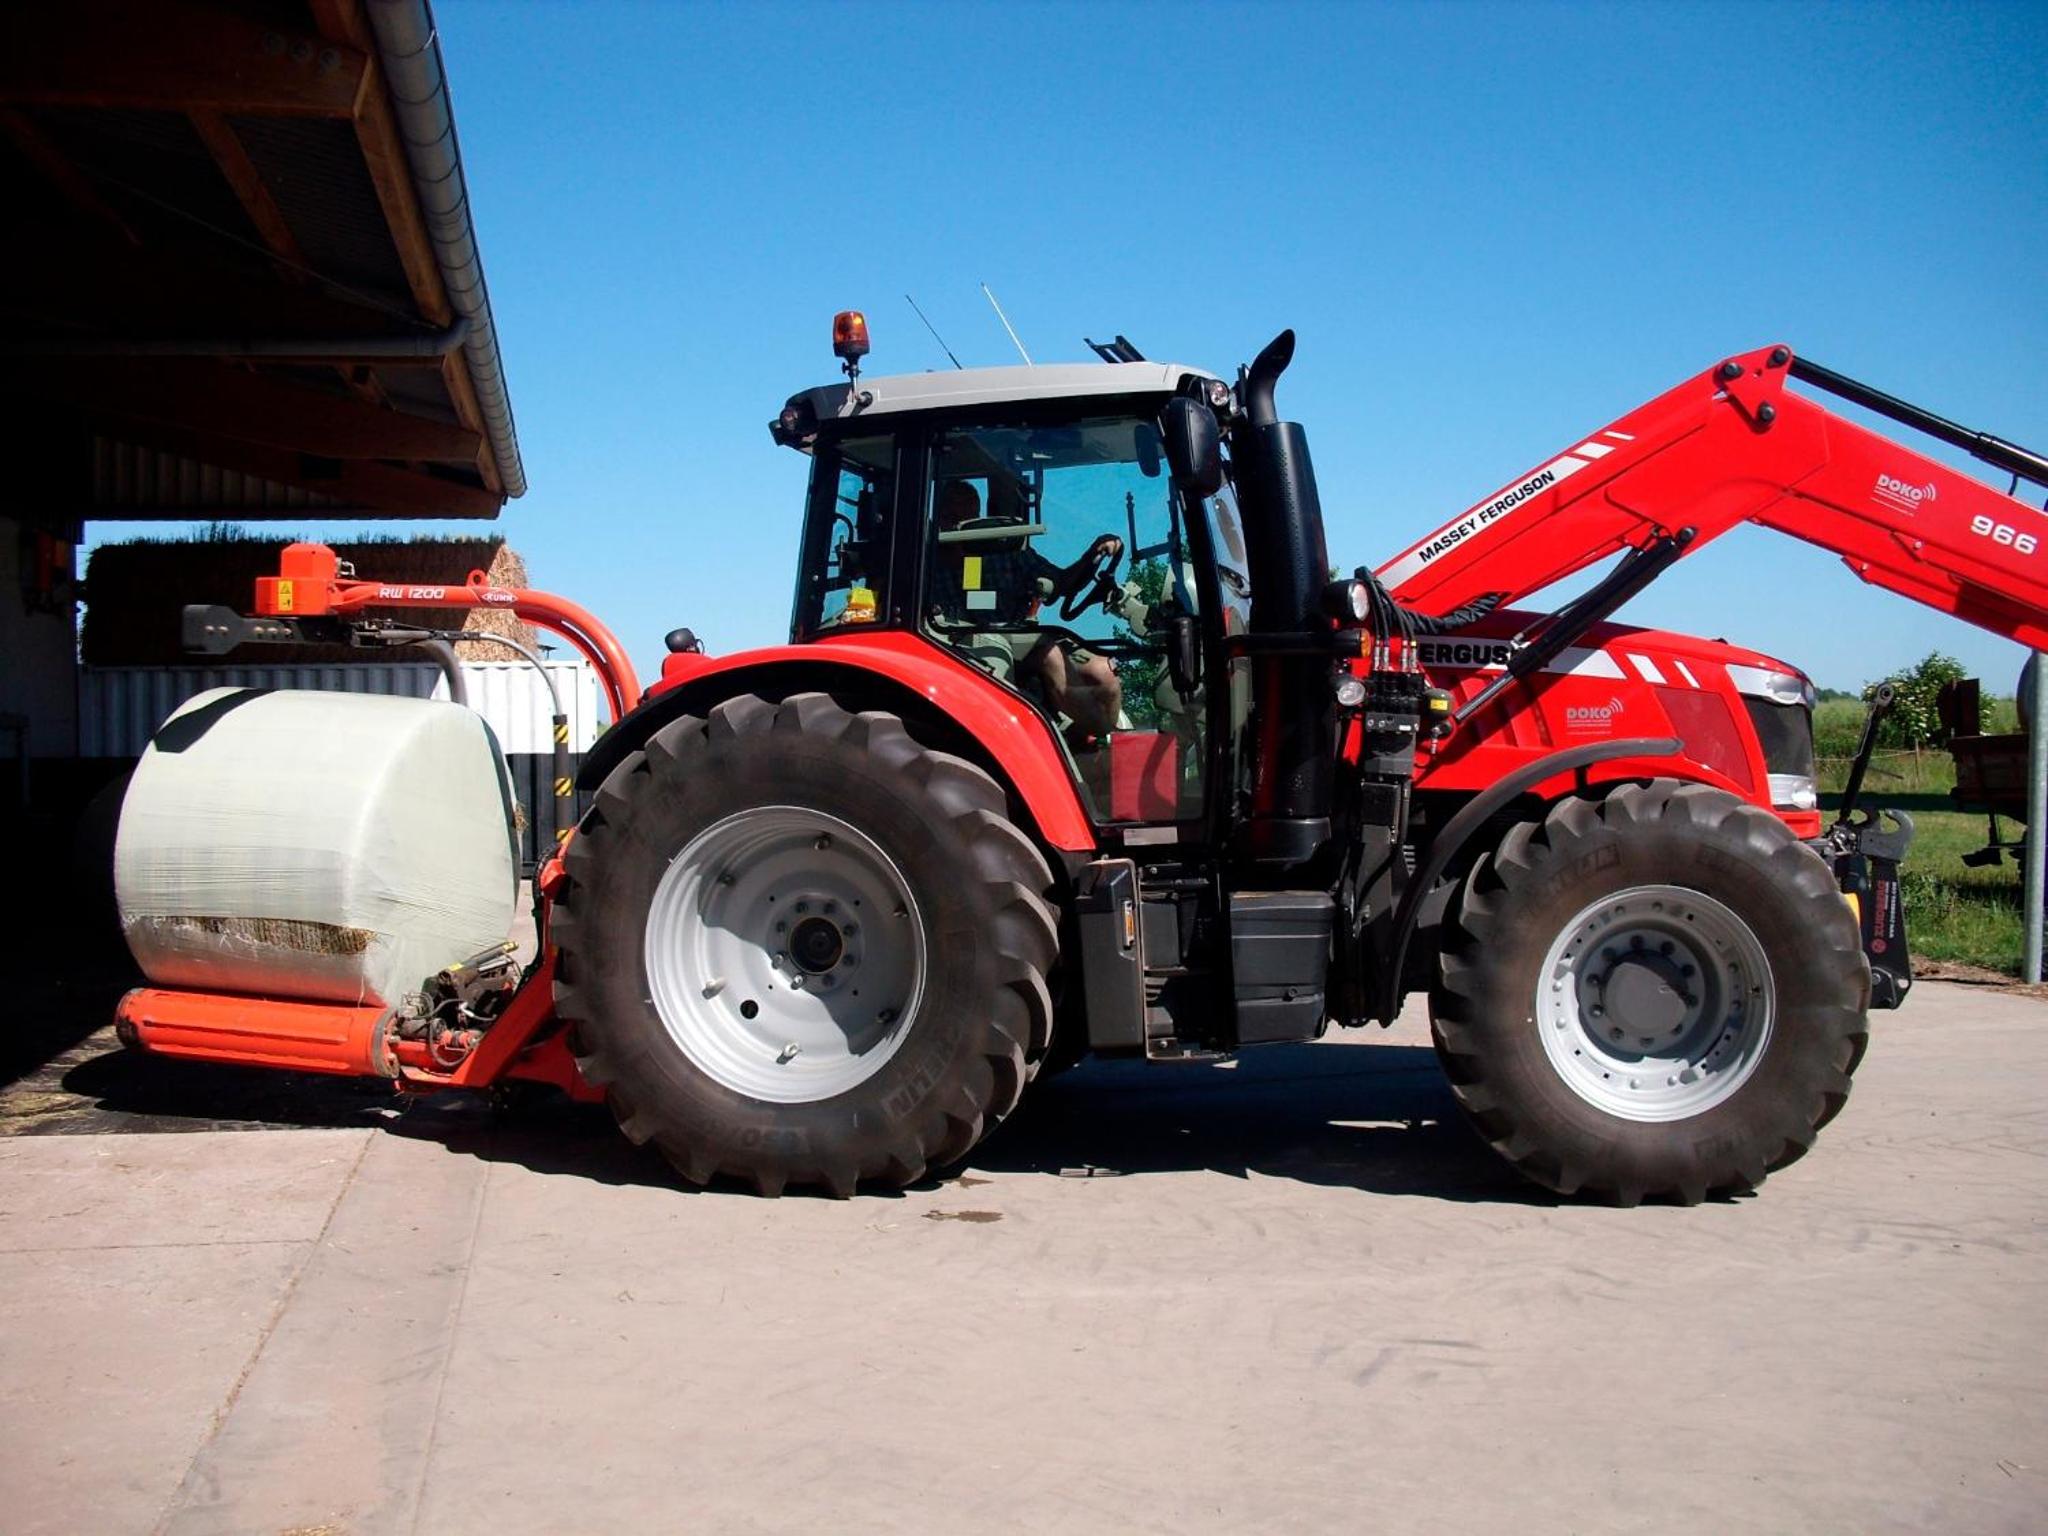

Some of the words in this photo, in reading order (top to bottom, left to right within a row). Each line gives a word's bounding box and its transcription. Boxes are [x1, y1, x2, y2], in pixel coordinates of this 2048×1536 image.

[1877, 473, 1923, 501] DOKO
[1418, 517, 1477, 563] MASSEY
[1478, 470, 1555, 524] FERGUSON
[1970, 514, 2038, 555] 966
[379, 588, 403, 599] RW
[408, 588, 446, 599] 1200
[1418, 643, 1511, 665] ERGUS
[1566, 707, 1612, 719] DOKO
